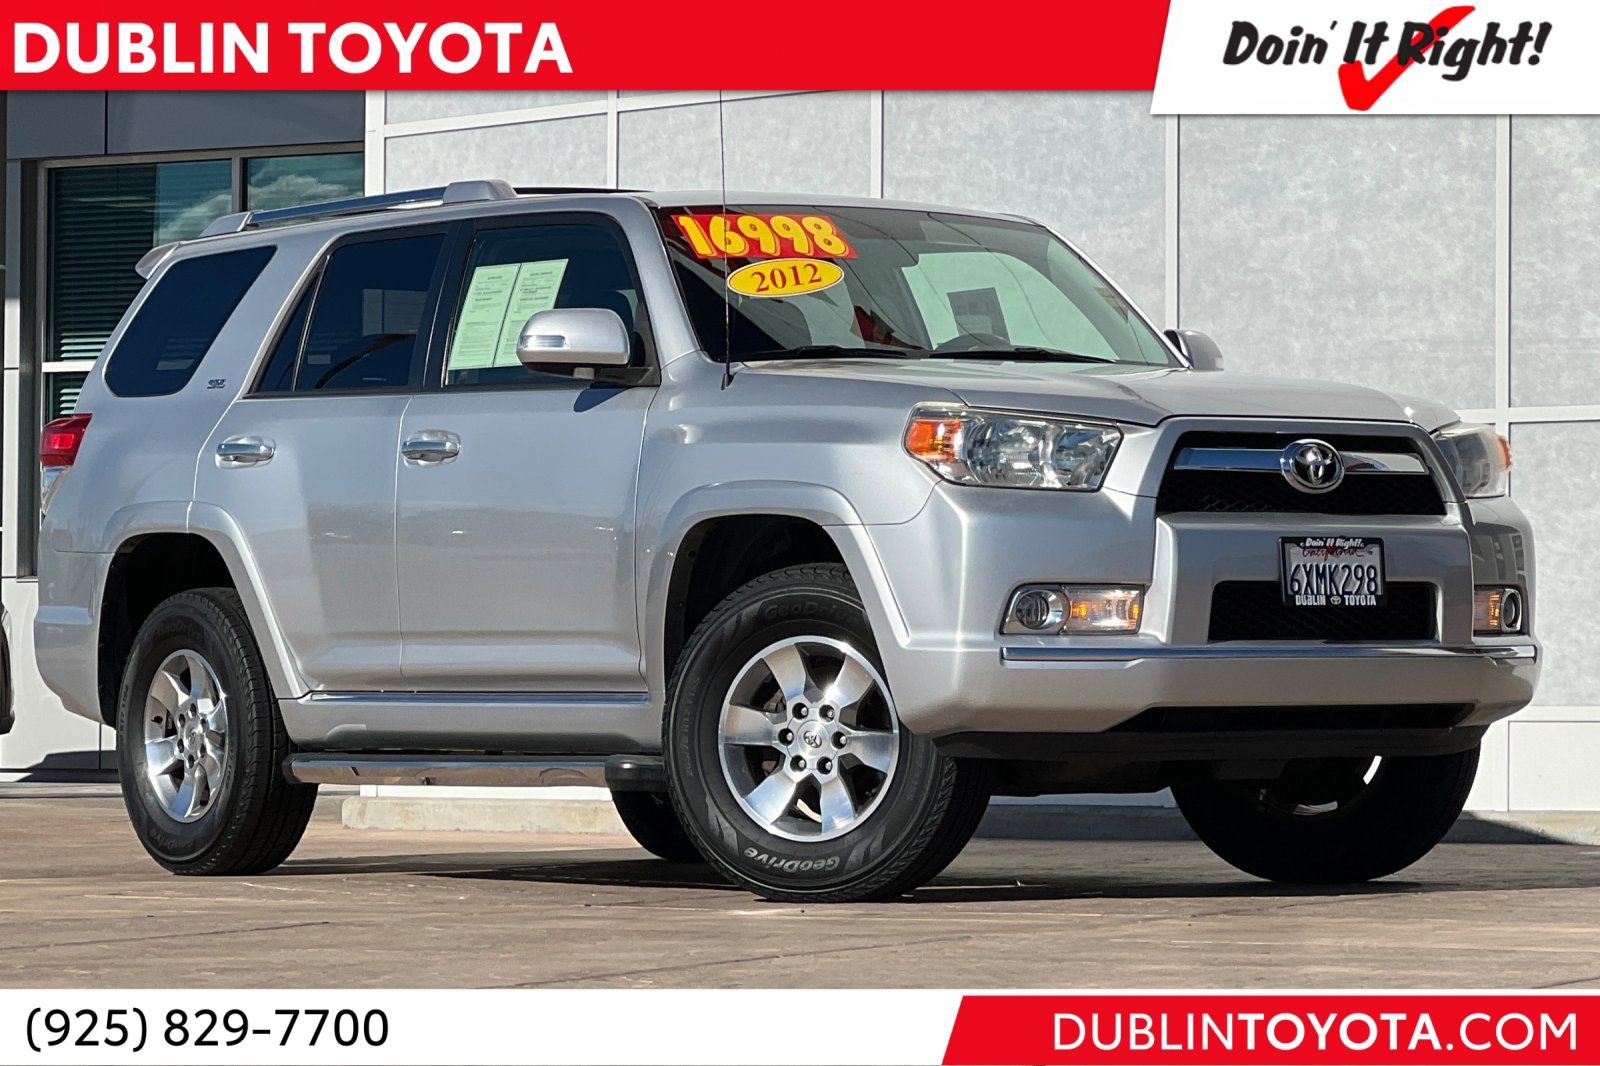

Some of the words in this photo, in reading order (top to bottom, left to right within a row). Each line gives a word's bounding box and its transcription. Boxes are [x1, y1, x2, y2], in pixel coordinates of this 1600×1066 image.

[678, 215, 850, 257] 16998
[751, 263, 822, 293] 2012
[1305, 538, 1326, 547] Doin'
[1336, 538, 1363, 550] Right!
[1290, 564, 1378, 596] 6XMK298
[1295, 594, 1327, 606] DUBLIN
[1343, 594, 1377, 606] TOYOTA
[743, 846, 841, 873] GeoDrive
